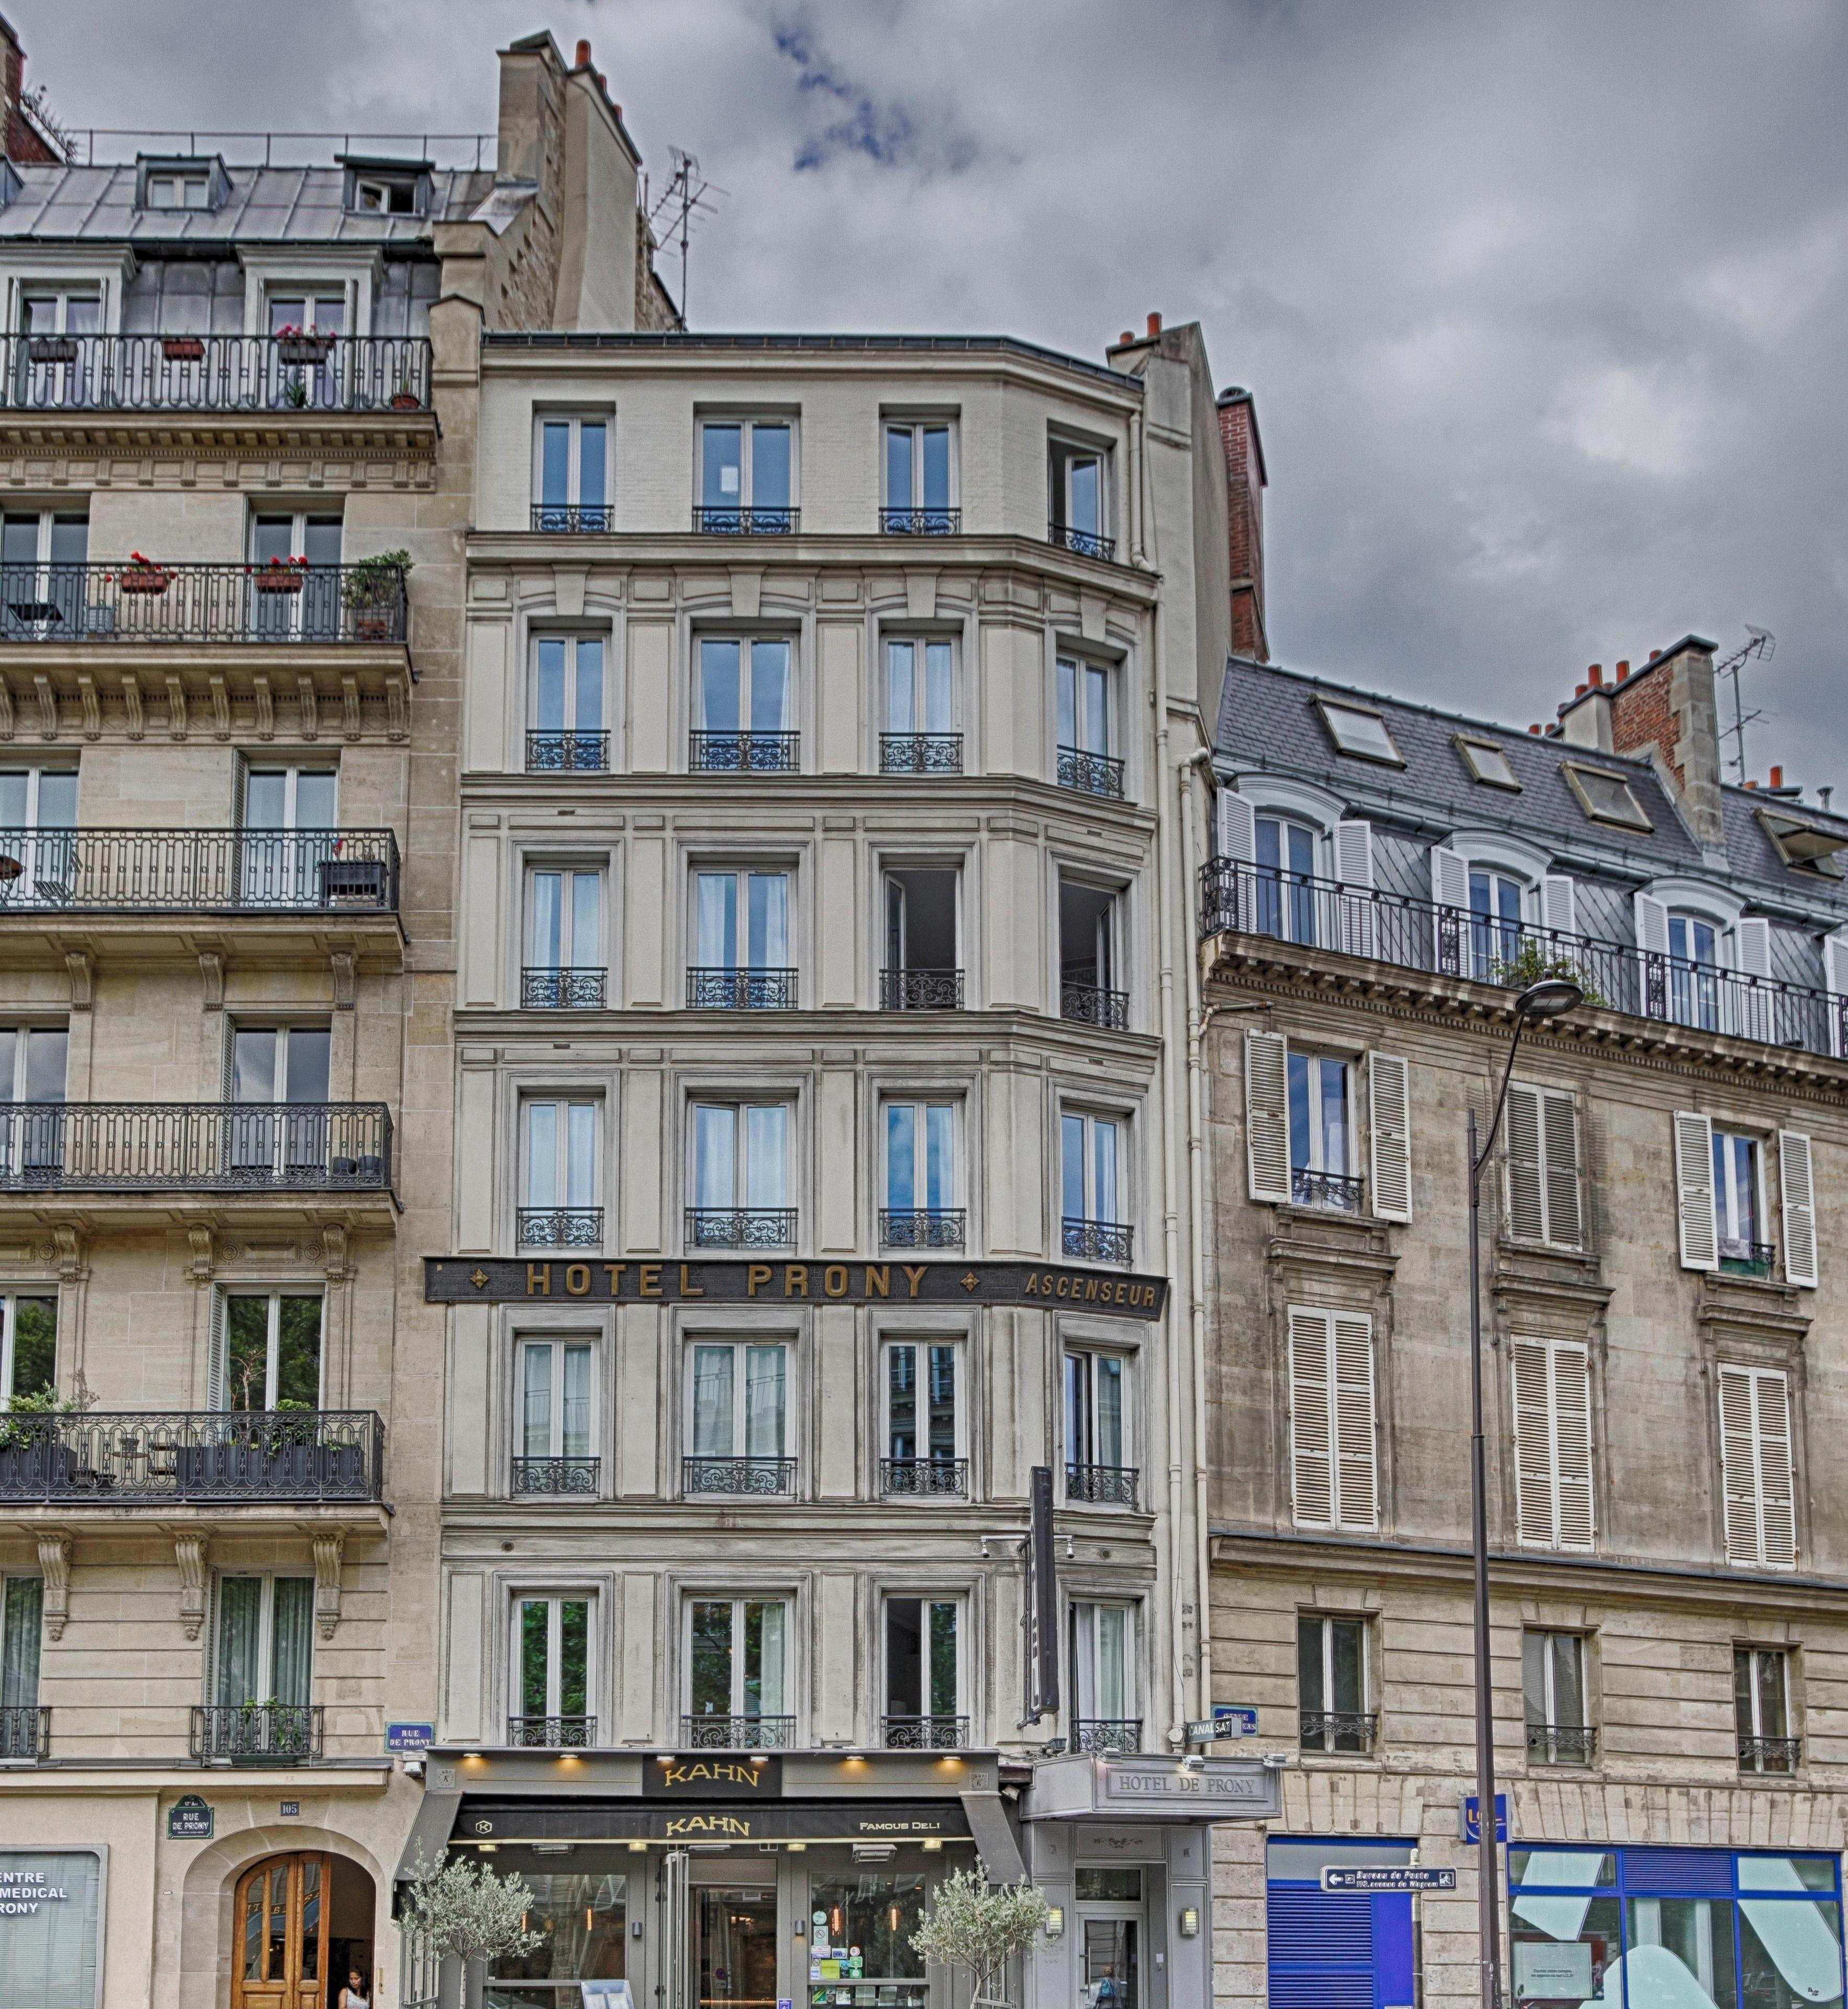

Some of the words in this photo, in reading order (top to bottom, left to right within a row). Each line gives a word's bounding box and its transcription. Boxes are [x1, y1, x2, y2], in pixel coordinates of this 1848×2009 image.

[527, 1264, 704, 1297] HOTEL
[748, 1265, 928, 1299] PRONY
[1025, 1273, 1155, 1307] ASCENSEUR
[665, 1764, 759, 1787] KAHN
[1119, 1776, 1171, 1791] HOTEL
[1179, 1778, 1199, 1791] DE
[1207, 1778, 1255, 1793] PRONY
[283, 1804, 297, 1814] 105
[666, 1816, 750, 1837] KAHN
[1357, 1871, 1388, 1879] Bureau
[1404, 1871, 1429, 1879] Poste
[0, 1887, 67, 1898] MEDICAL
[1410, 1880, 1438, 1889] Wagram
